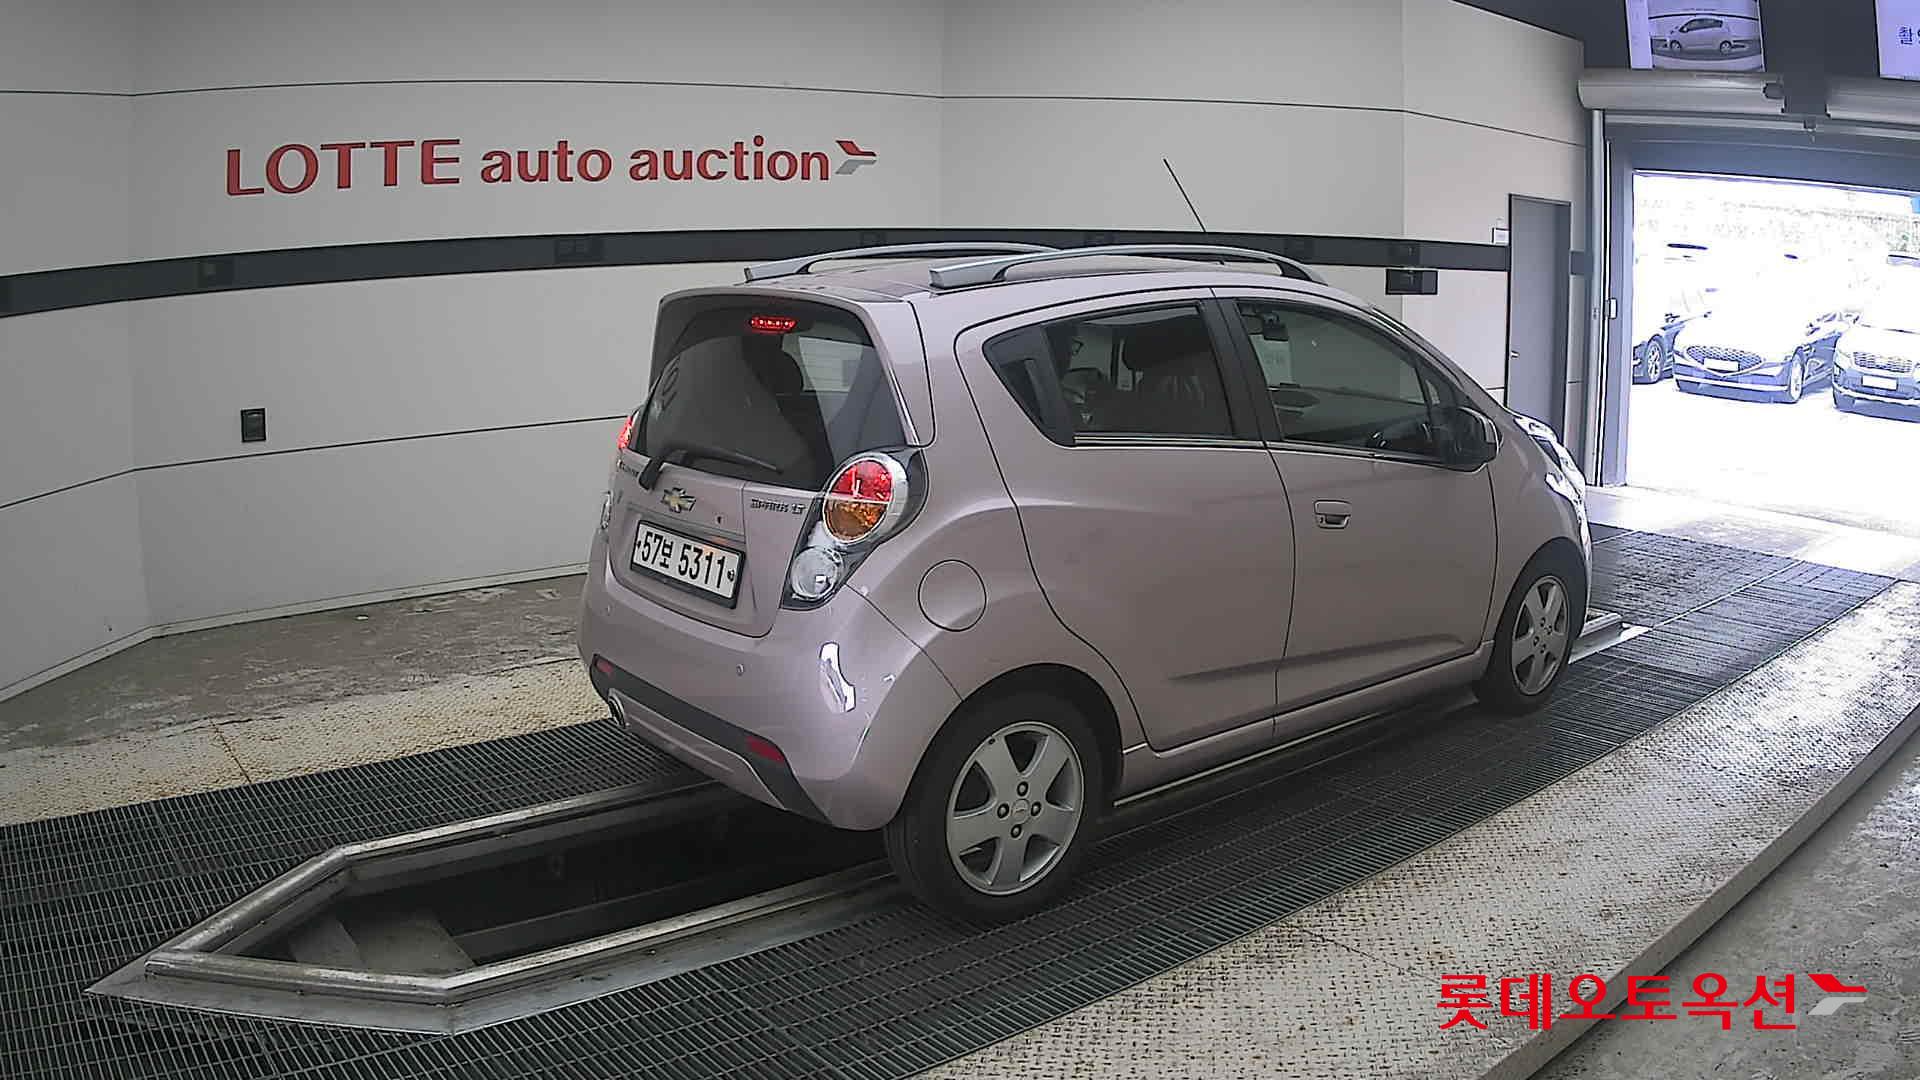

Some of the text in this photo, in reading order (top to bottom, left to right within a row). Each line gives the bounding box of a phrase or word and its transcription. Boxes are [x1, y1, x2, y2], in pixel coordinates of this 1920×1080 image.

[228, 136, 830, 195] LOTTE auto auction
[641, 530, 726, 589] 57보 5311
